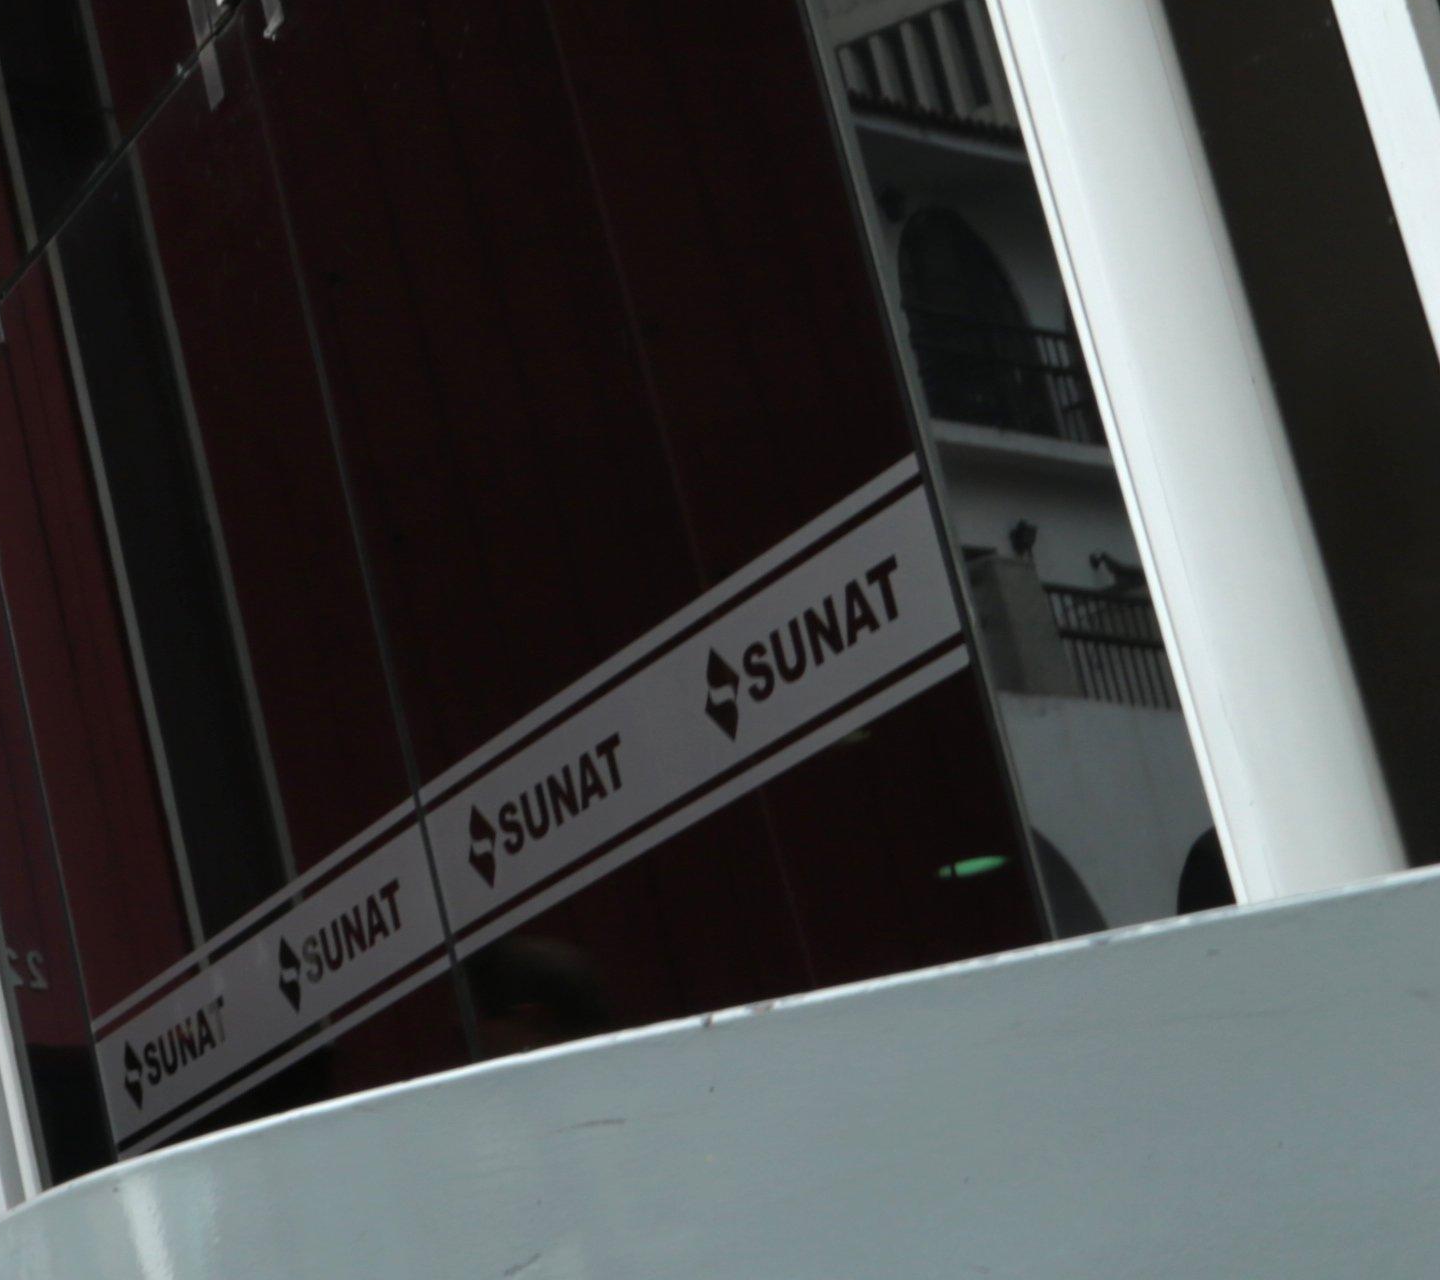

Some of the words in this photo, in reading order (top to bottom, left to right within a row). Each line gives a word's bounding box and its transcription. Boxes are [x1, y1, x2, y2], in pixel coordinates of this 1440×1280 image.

[742, 553, 899, 703] SUNAT
[498, 731, 622, 856] SUNAT
[302, 877, 401, 984] SUNAT
[143, 994, 226, 1087] SUNAT
